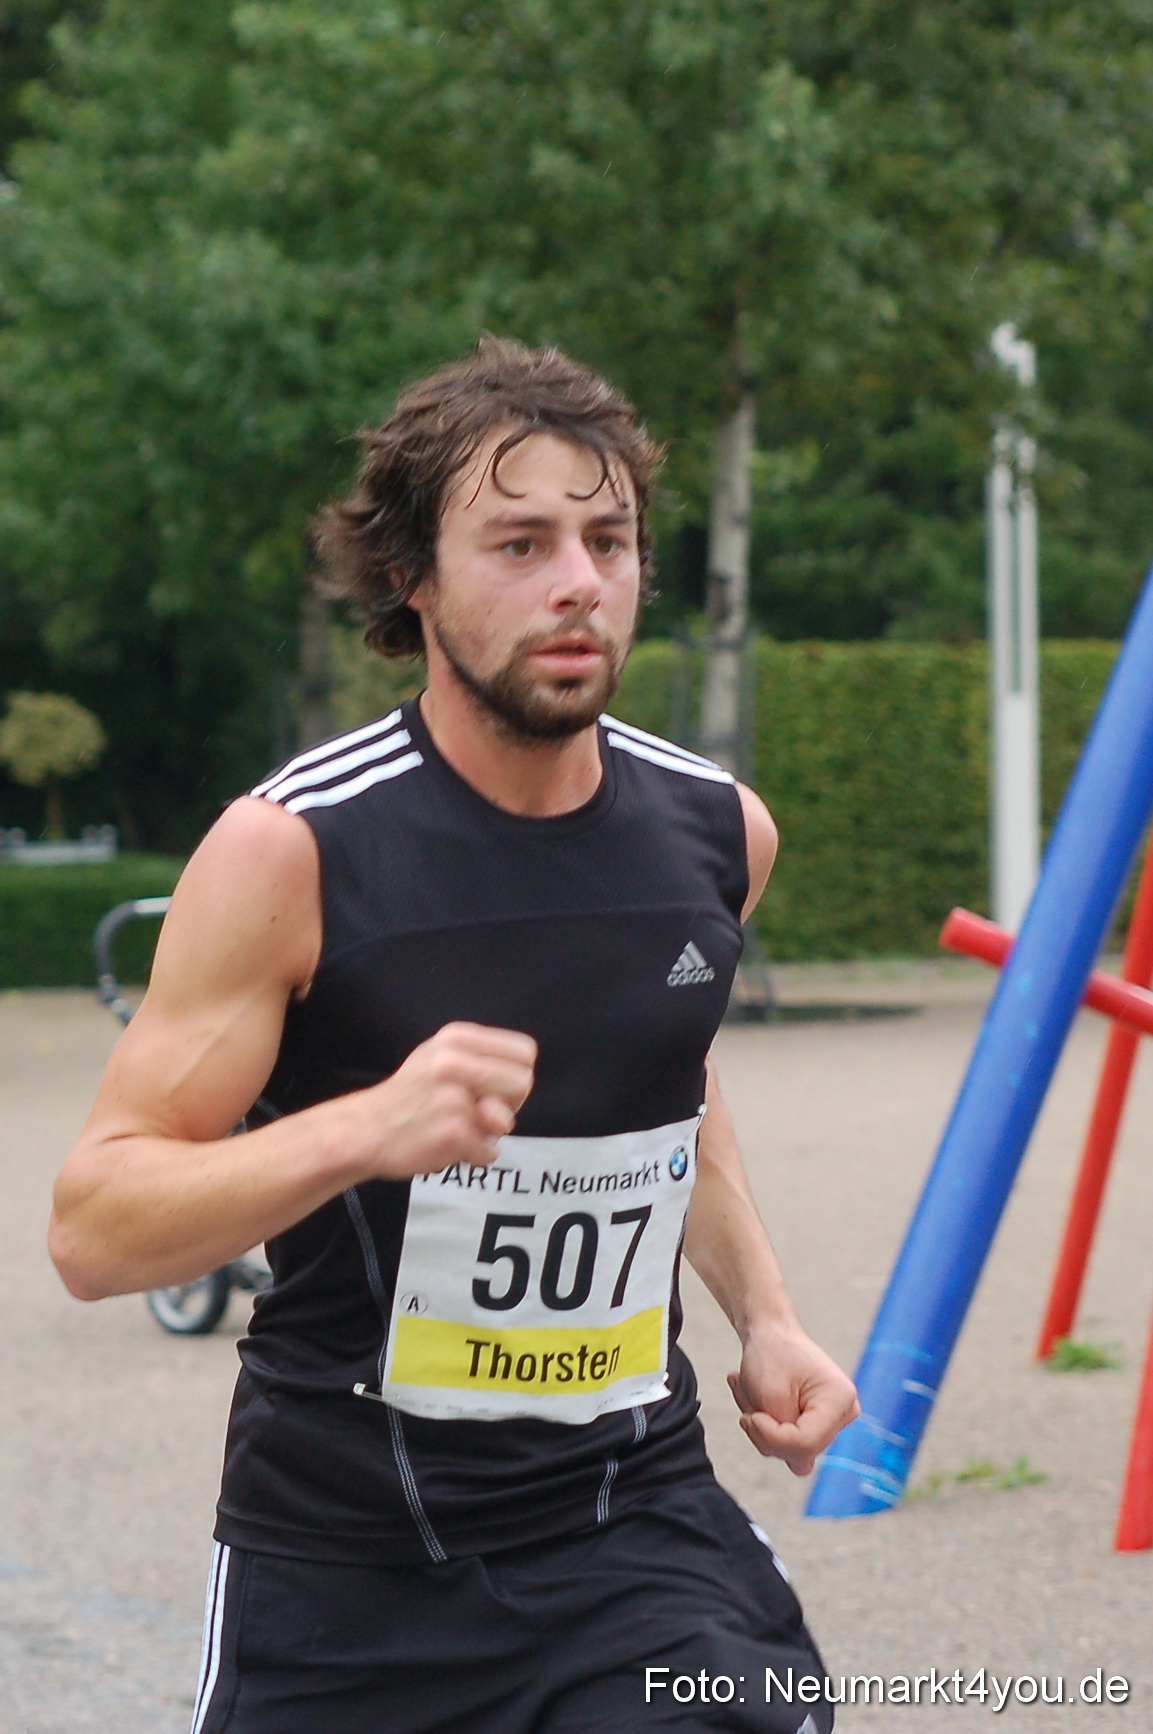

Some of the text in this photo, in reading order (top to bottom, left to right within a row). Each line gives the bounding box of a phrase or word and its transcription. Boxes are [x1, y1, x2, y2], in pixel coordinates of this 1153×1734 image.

[667, 965, 715, 987] adidas
[540, 1160, 660, 1195] Neumarkt
[472, 1204, 653, 1311] 507
[466, 1339, 621, 1383] Thorsten
